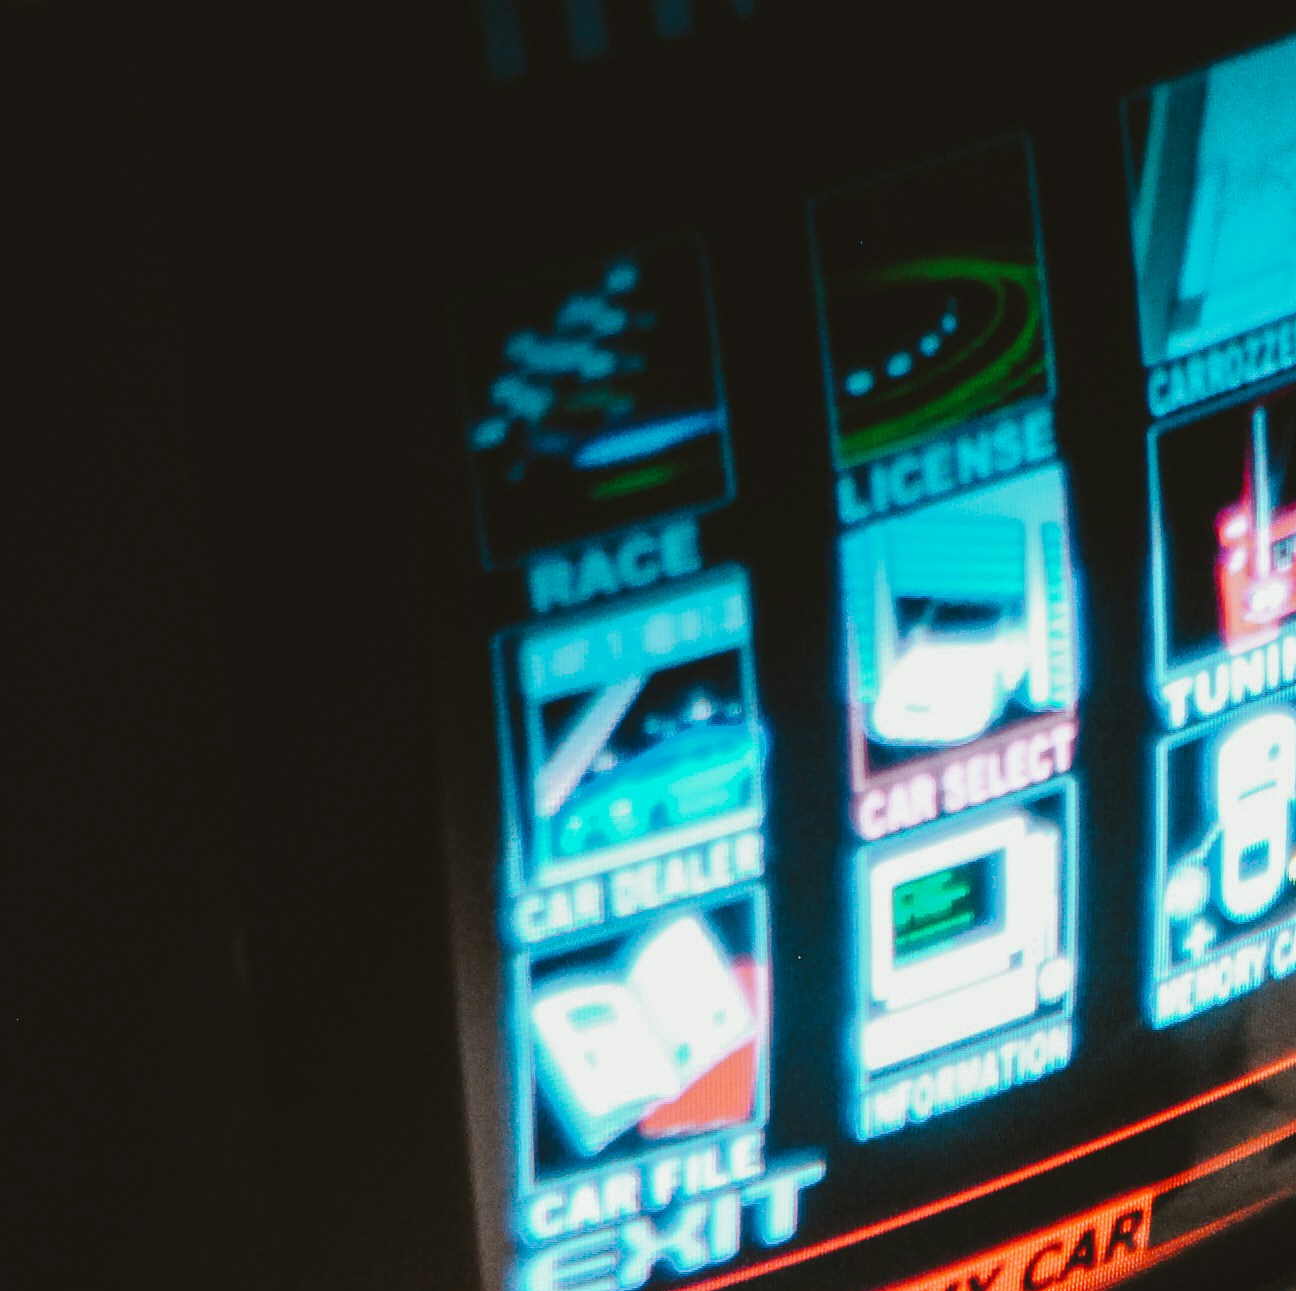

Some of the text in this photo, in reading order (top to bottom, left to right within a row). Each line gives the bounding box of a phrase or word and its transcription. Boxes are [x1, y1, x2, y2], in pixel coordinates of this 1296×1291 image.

[837, 407, 1057, 525] LICENSE
[529, 516, 703, 613] RACE
[858, 720, 1076, 842] CAR SELECT
[516, 832, 765, 944] CAR DEALER
[1152, 940, 1273, 1031] MEMORY
[856, 1025, 1074, 1141] INFORMATION
[527, 1129, 767, 1241] CAR FILE
